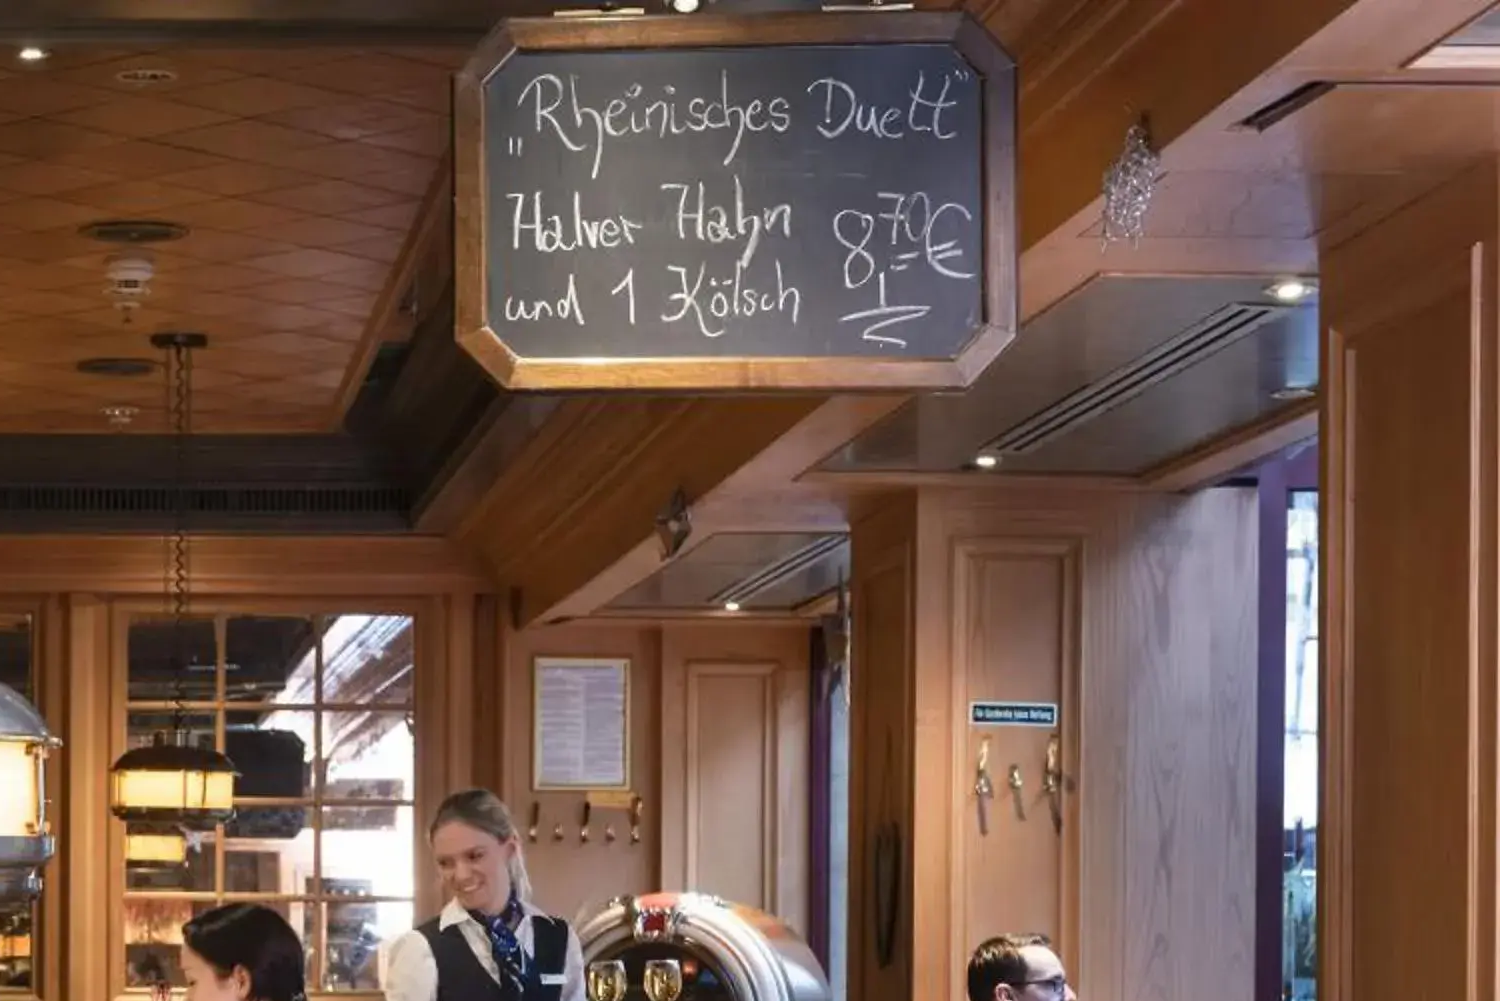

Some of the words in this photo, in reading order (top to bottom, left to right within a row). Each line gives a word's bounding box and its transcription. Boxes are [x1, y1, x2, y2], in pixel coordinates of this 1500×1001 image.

[506, 191, 642, 252] Halver
[661, 175, 791, 268] Hahn
[505, 275, 584, 324] und
[612, 268, 634, 324] 1
[661, 261, 800, 337] Kölsch
